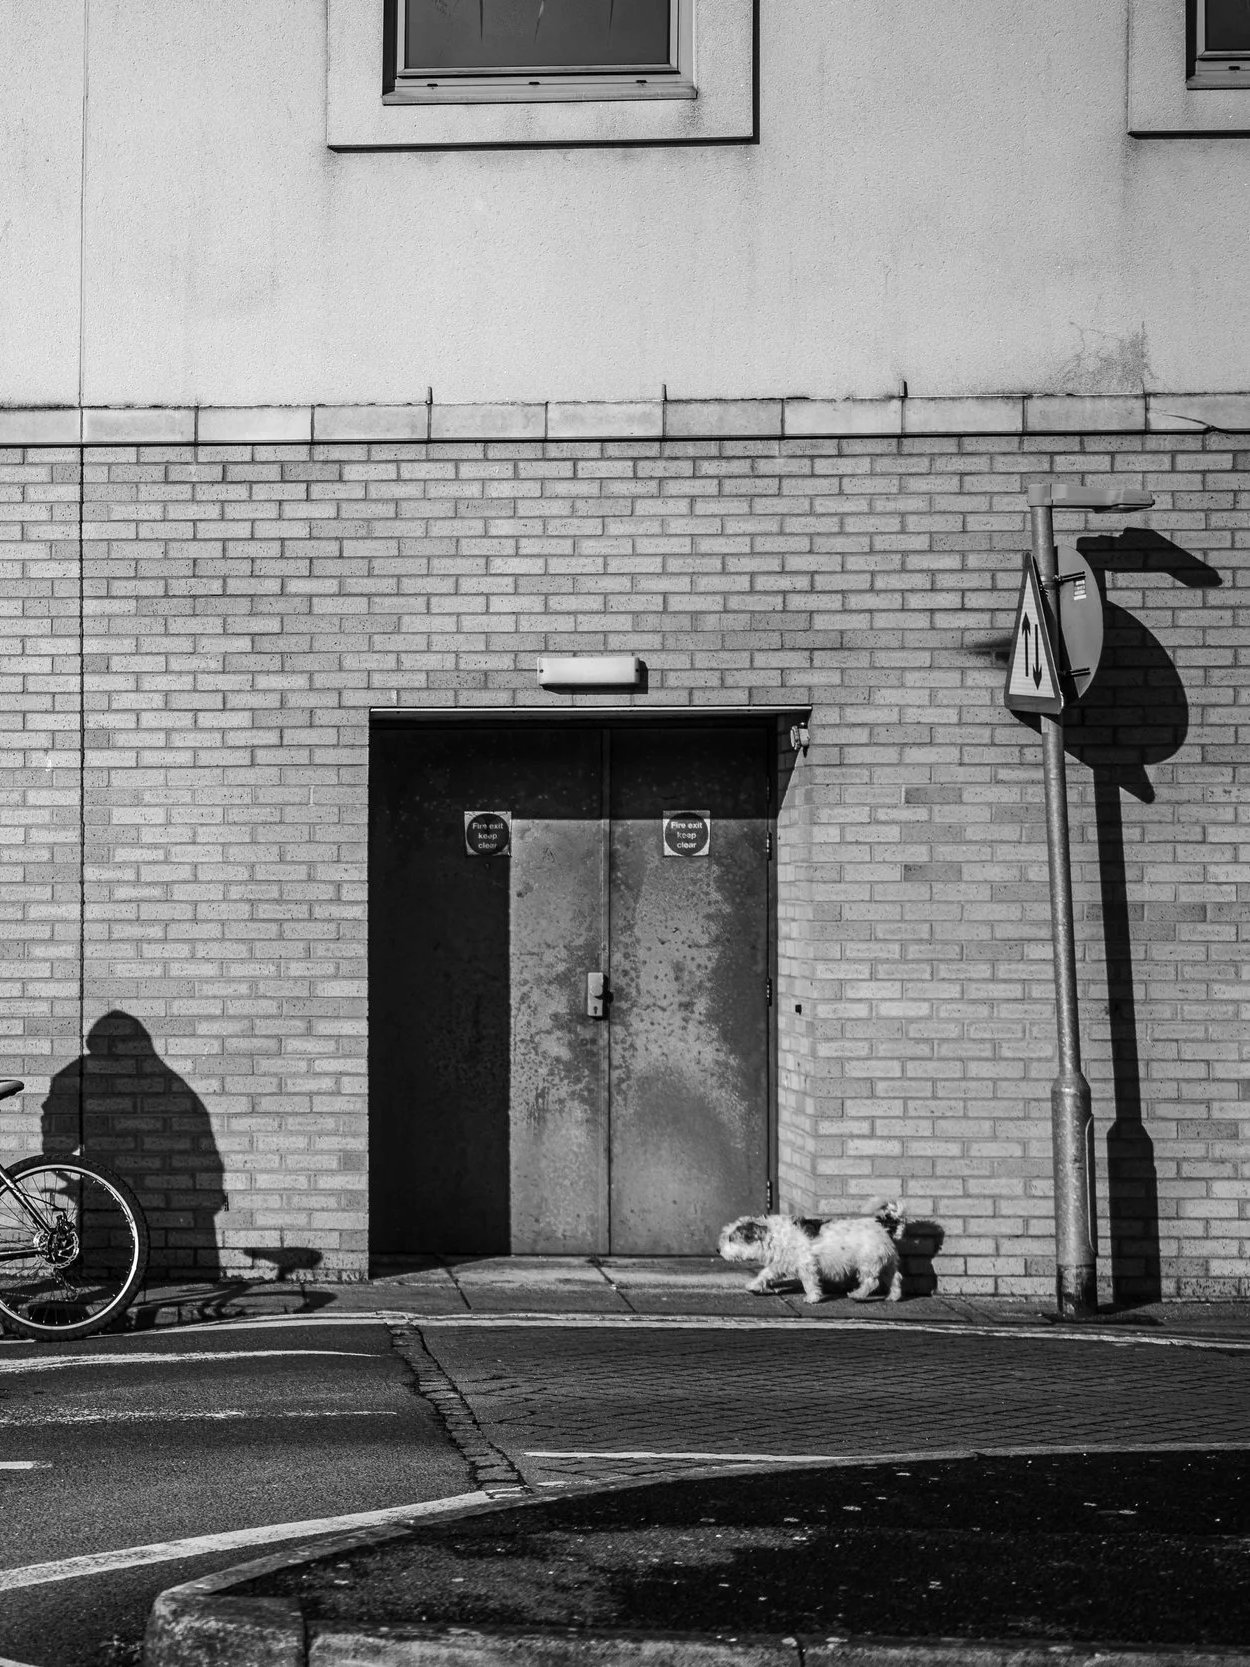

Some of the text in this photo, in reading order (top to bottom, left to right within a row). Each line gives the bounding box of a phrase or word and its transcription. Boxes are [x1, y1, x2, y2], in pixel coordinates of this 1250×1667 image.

[670, 821, 703, 829] Fire exit
[478, 832, 498, 840] keep
[676, 831, 697, 840] keep
[676, 841, 697, 849] clear
